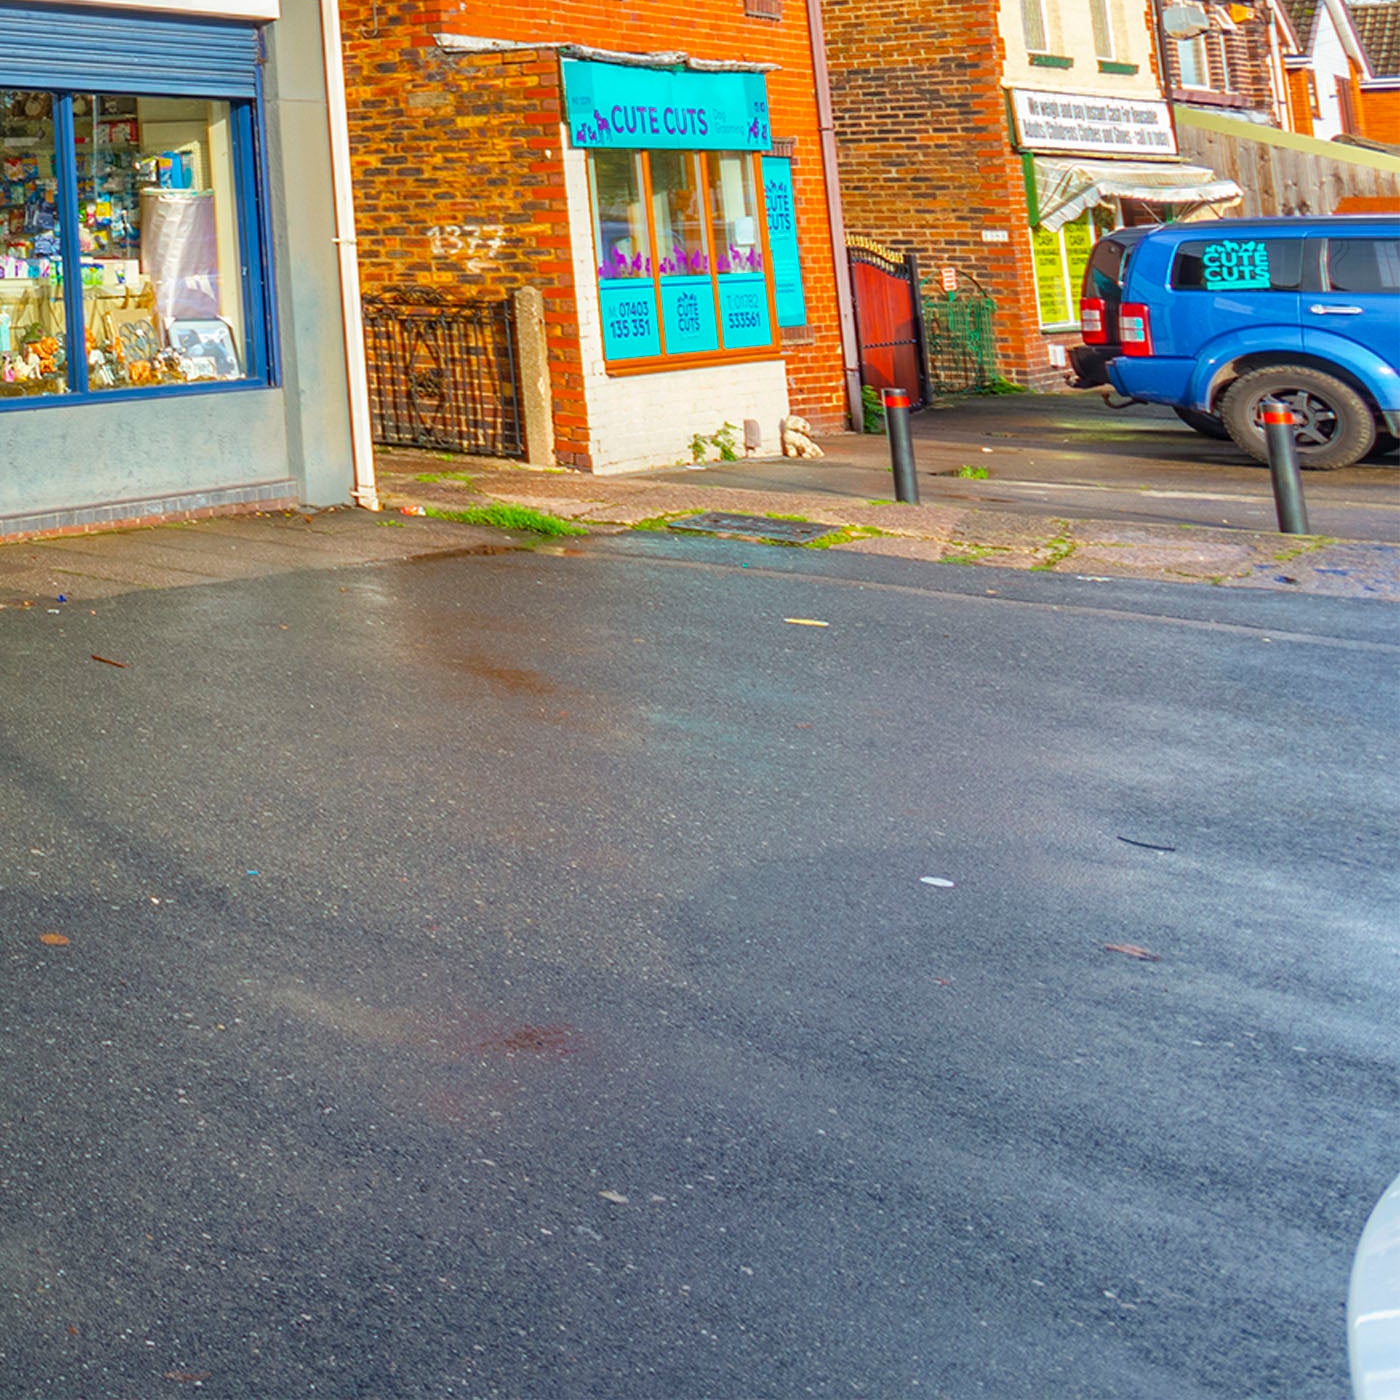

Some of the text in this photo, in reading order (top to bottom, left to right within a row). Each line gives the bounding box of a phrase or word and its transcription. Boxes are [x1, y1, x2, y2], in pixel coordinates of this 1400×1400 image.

[611, 104, 708, 136] CUTE CUTS
[1203, 251, 1269, 267] CUTE
[1204, 266, 1271, 281] CUTS
[618, 301, 649, 318] 07403
[676, 303, 699, 317] CUTE
[610, 318, 650, 339] 135 351
[677, 317, 700, 332] CUTS
[728, 312, 761, 329] 533561
